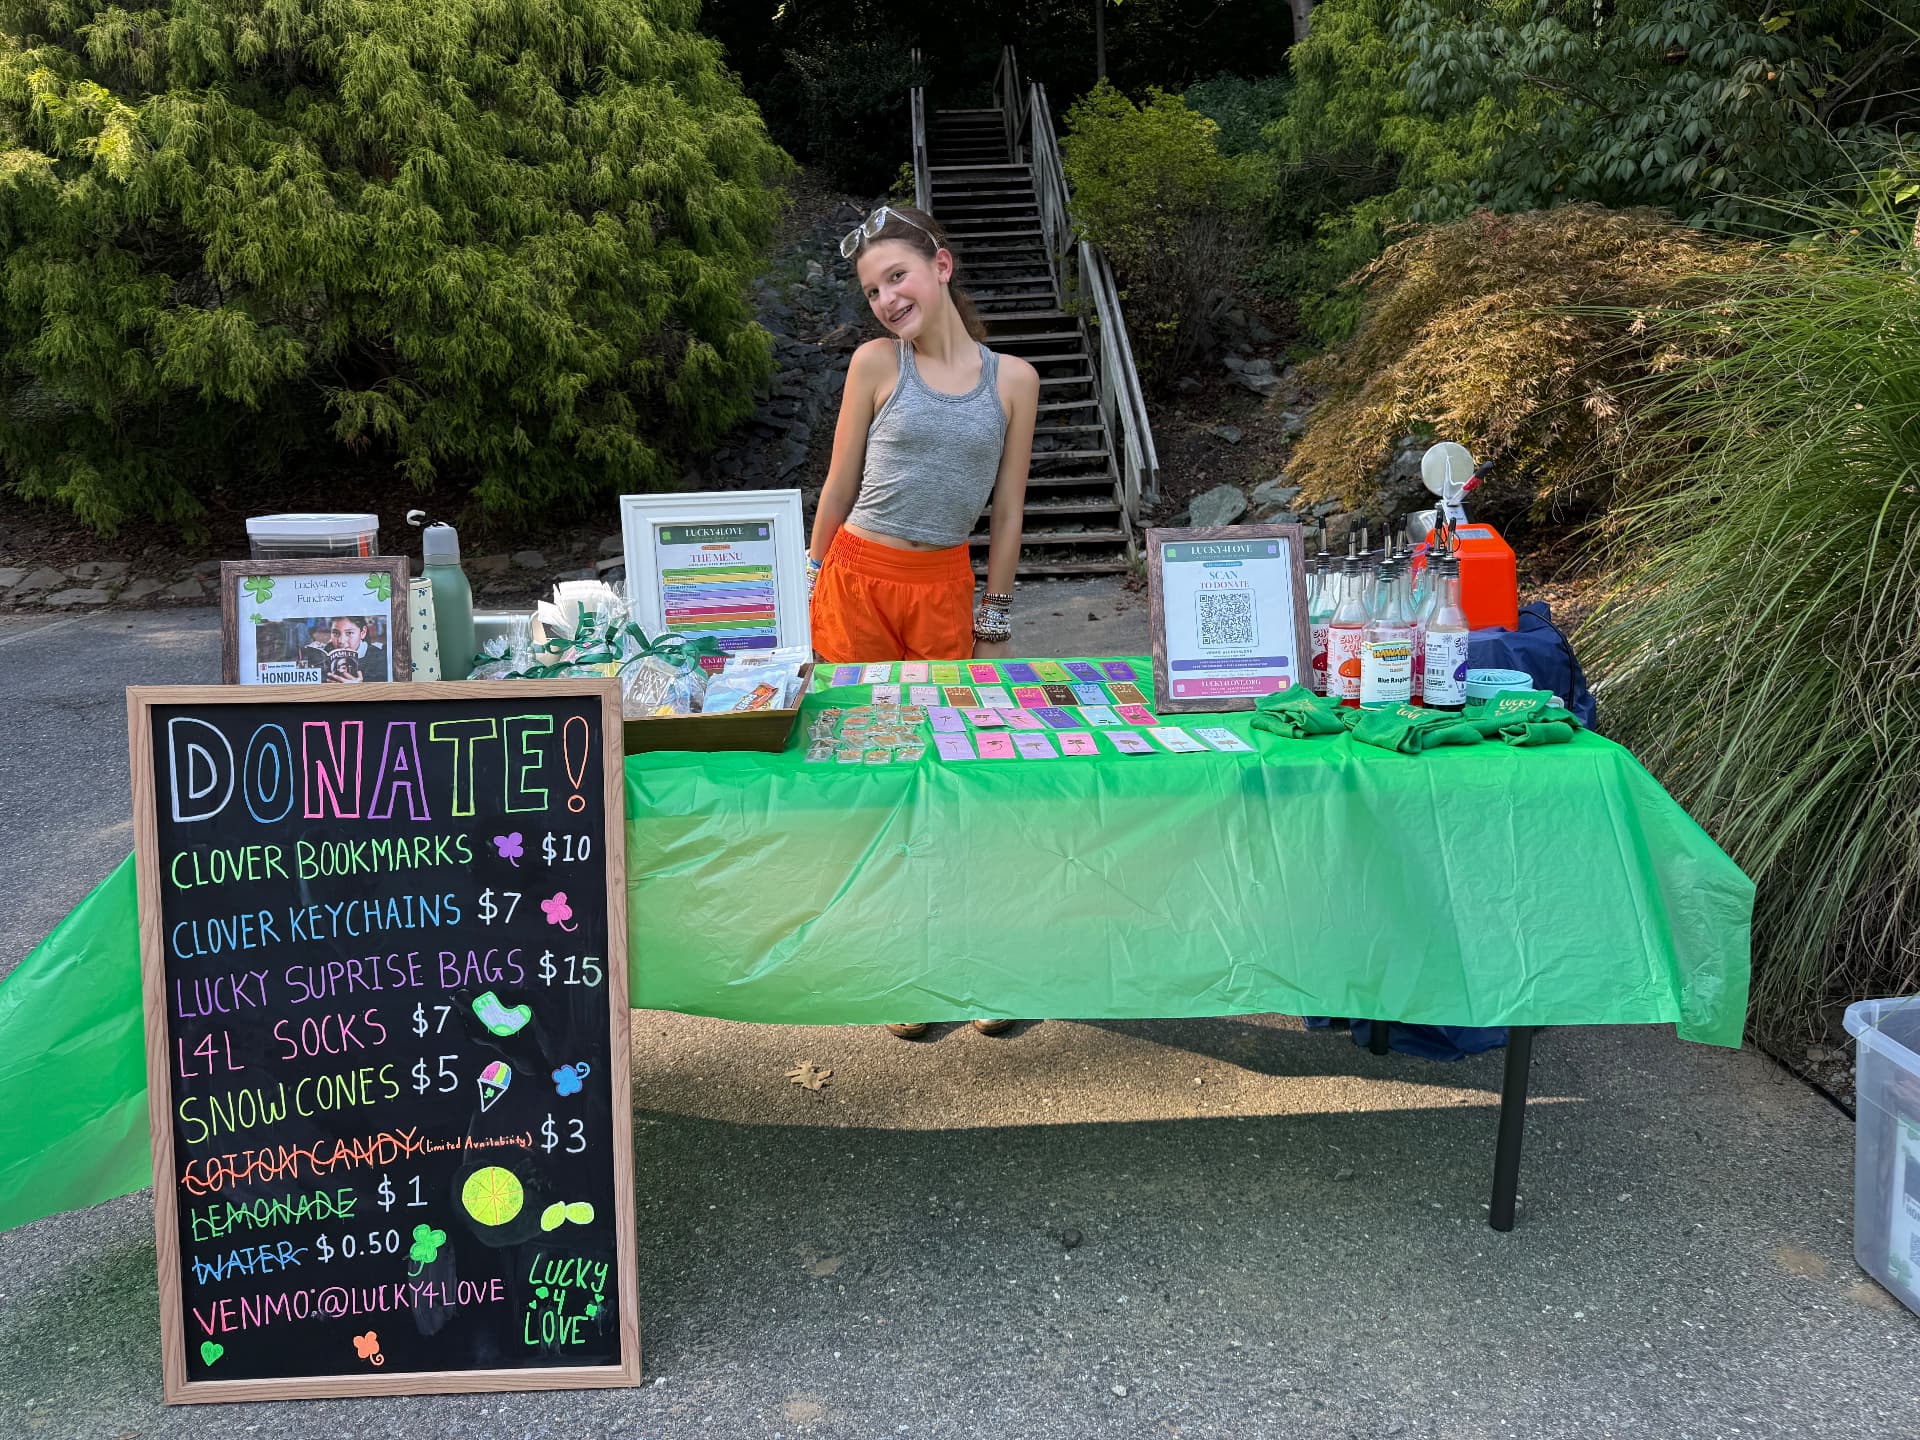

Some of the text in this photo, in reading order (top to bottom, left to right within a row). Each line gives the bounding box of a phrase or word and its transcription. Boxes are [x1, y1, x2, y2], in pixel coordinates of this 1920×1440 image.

[685, 528, 744, 536] LUCKY4LOVE
[1192, 545, 1253, 555] LUCKY4LOVE
[690, 552, 743, 563] THE MENU
[1209, 571, 1238, 580] SCAN
[294, 580, 347, 590] Lucky4Love
[297, 594, 345, 604] Fundraiser
[1215, 580, 1249, 588] DONATE
[262, 671, 318, 683] HONDURAS
[168, 715, 590, 823] DONATE!
[171, 831, 591, 889] CLOVER BOOKMARKS $10
[172, 888, 522, 959] CLOVER KEYCHAINS $7
[177, 949, 602, 1018] LUCKY SUPRISE BAGS $15
[179, 1005, 451, 1078] L4L SOCKS $7
[180, 1055, 459, 1144] SNOW CONES $5
[181, 1149, 301, 1195] COTTON
[311, 1127, 419, 1176] CANDY
[541, 1114, 587, 1153] $3
[192, 1188, 358, 1241] LEMONADE
[192, 1229, 400, 1285] WATER $0.50
[529, 1253, 609, 1294] LUCKY
[552, 1289, 565, 1316] 4
[524, 1313, 586, 1345] LOVE
